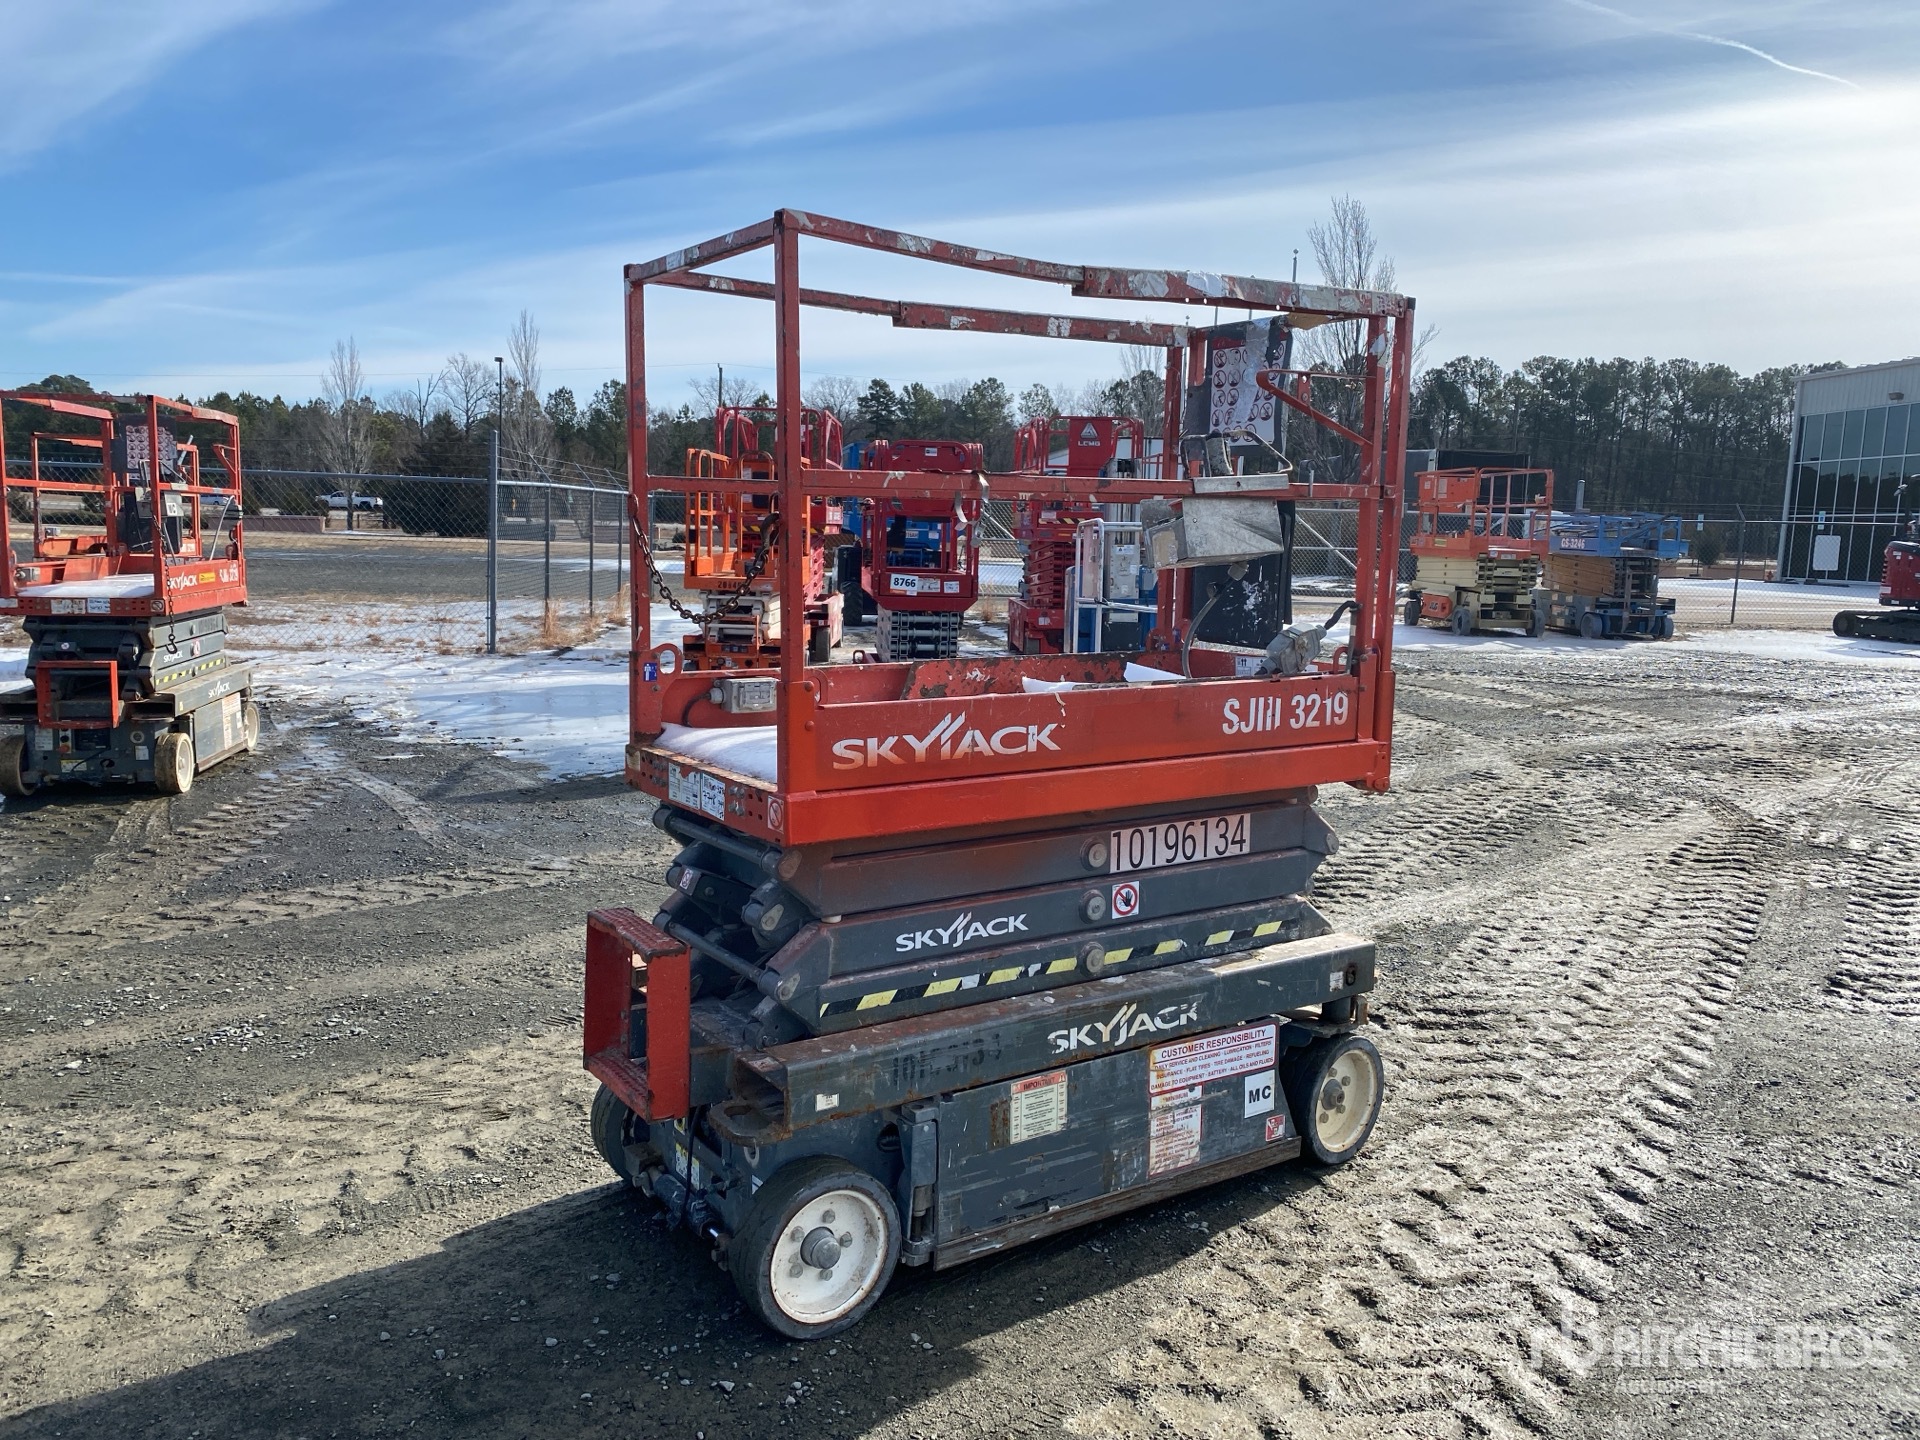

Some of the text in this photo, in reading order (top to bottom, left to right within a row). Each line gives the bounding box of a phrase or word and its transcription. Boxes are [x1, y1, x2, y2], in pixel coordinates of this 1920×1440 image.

[1561, 538, 1585, 550] GS-3246
[893, 577, 916, 588] 8766
[1289, 691, 1349, 729] 3219
[832, 710, 1062, 770] SKYJACK
[1112, 814, 1247, 872] 10196134
[895, 911, 1029, 952] SKYJACK
[1047, 1002, 1198, 1054] SKYJACK
[1161, 1029, 1267, 1059] CUSTOMER RESPONSIBILITY
[1188, 1056, 1198, 1064] AND
[1198, 1050, 1221, 1061] CLEANING
[1223, 1045, 1252, 1056] LUBRICATION
[1254, 1040, 1272, 1049] FILTERS
[1198, 1062, 1211, 1070] TIRES
[1224, 1055, 1243, 1065] DAMAGE
[1246, 1050, 1270, 1059] REFUELING
[1150, 1081, 1171, 1091] DAMAGE
[1179, 1073, 1205, 1084] EQUIPMENT
[1207, 1067, 1228, 1077] BATTERY
[1239, 1062, 1250, 1070] OILS
[1259, 1057, 1274, 1066] FLUIDS
[1248, 1084, 1272, 1104] MC
